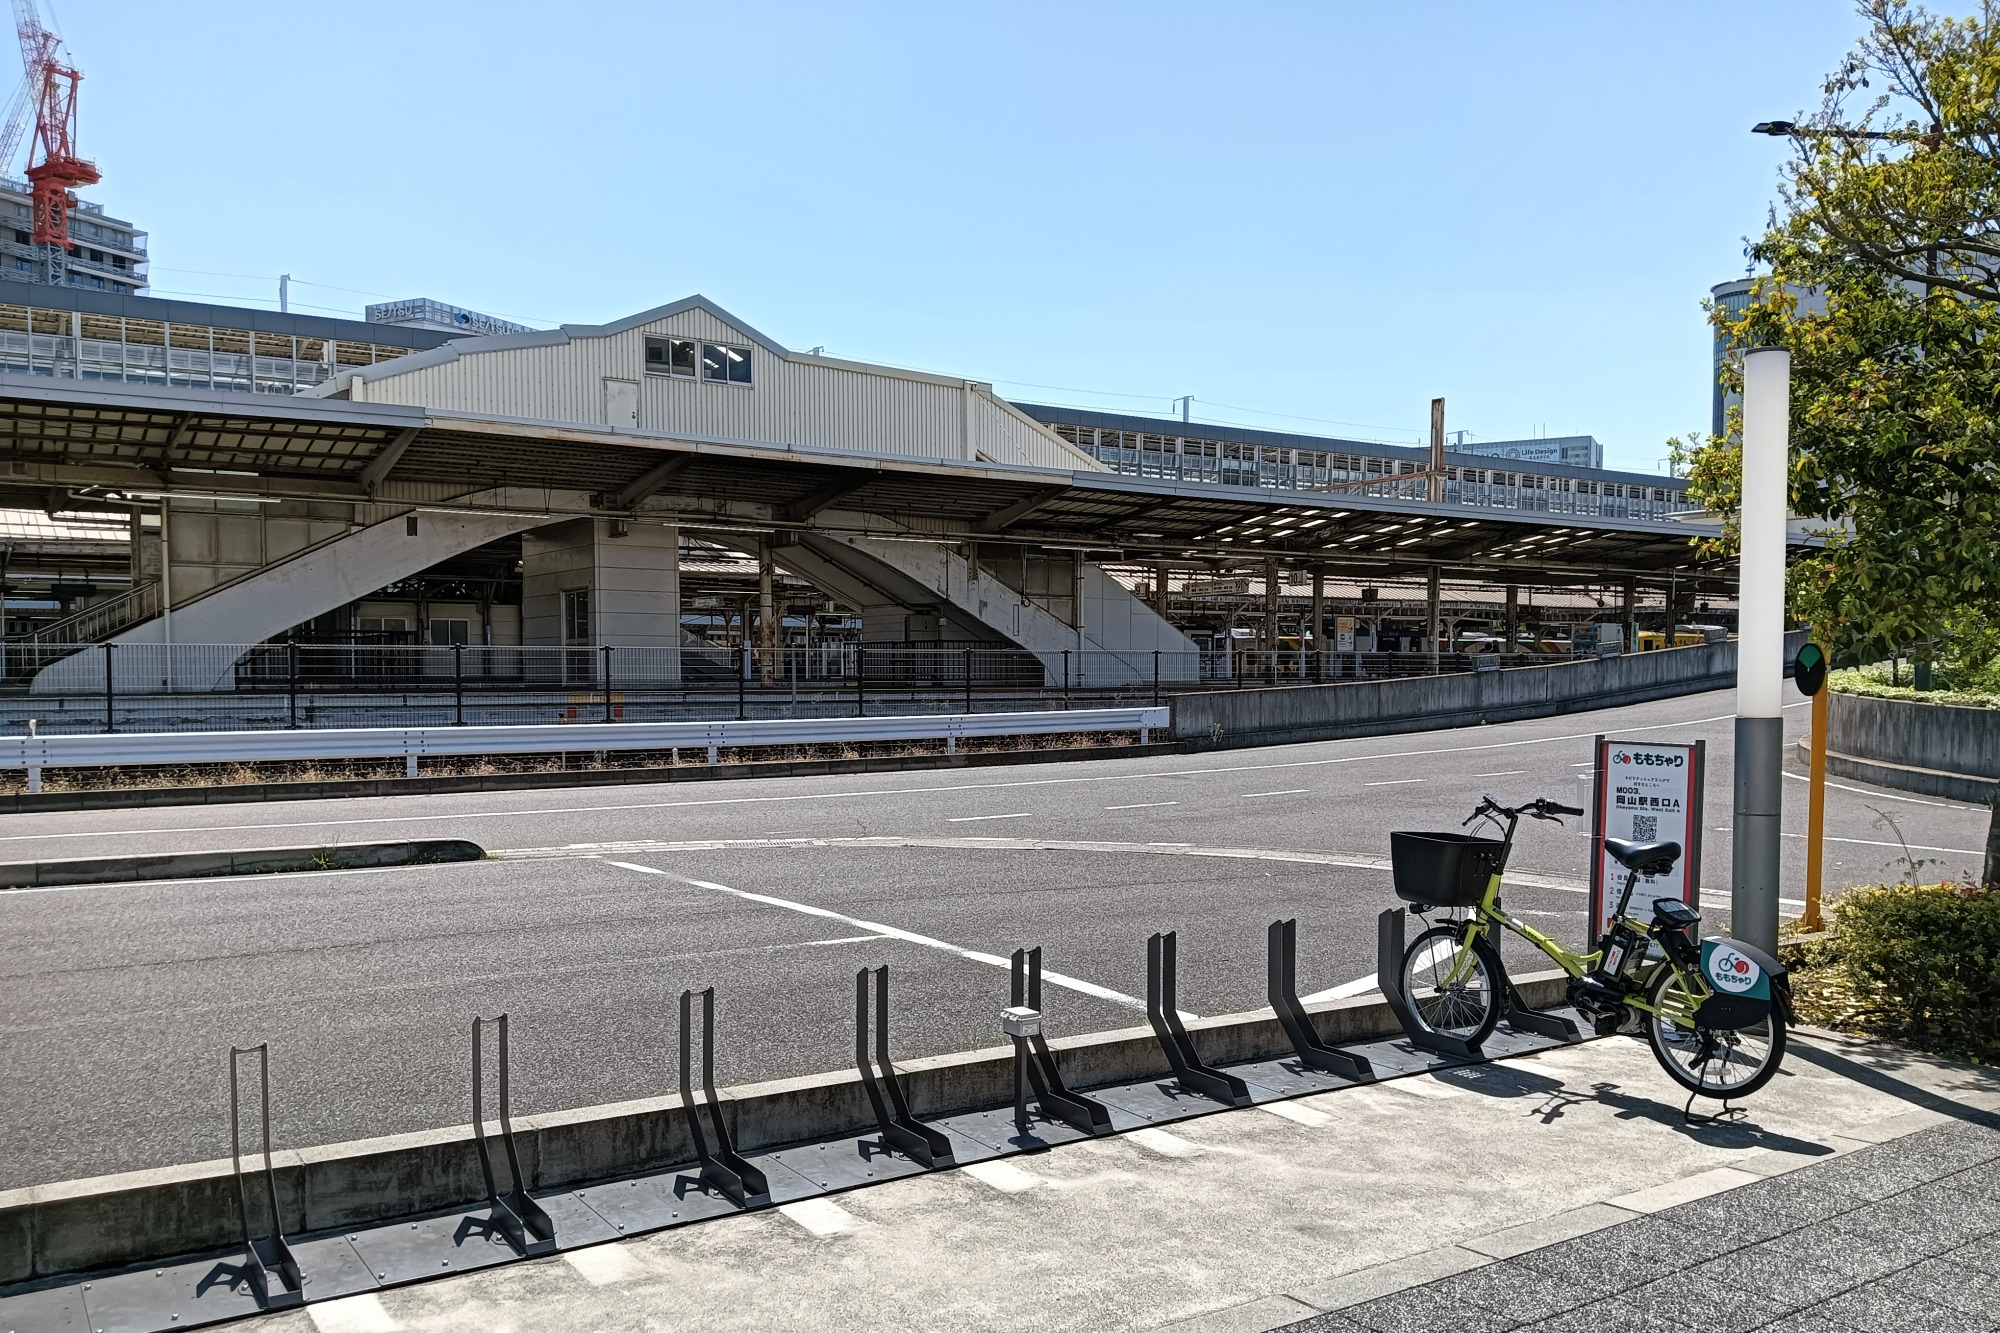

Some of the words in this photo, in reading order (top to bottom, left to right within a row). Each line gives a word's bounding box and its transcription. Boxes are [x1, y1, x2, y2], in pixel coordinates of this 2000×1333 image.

[1535, 447, 1558, 456] Design
[1290, 572, 1298, 584] 10
[1135, 585, 1141, 596] 9
[1185, 584, 1190, 593] 9
[1633, 752, 1684, 767] ももちゃり
[1616, 786, 1641, 795] M003.
[1616, 795, 1680, 808] 岡山駅西口A
[1610, 872, 1615, 881] 1
[1609, 886, 1615, 895] 2
[1608, 901, 1614, 909] 3
[1715, 972, 1752, 985] ももちゃり
